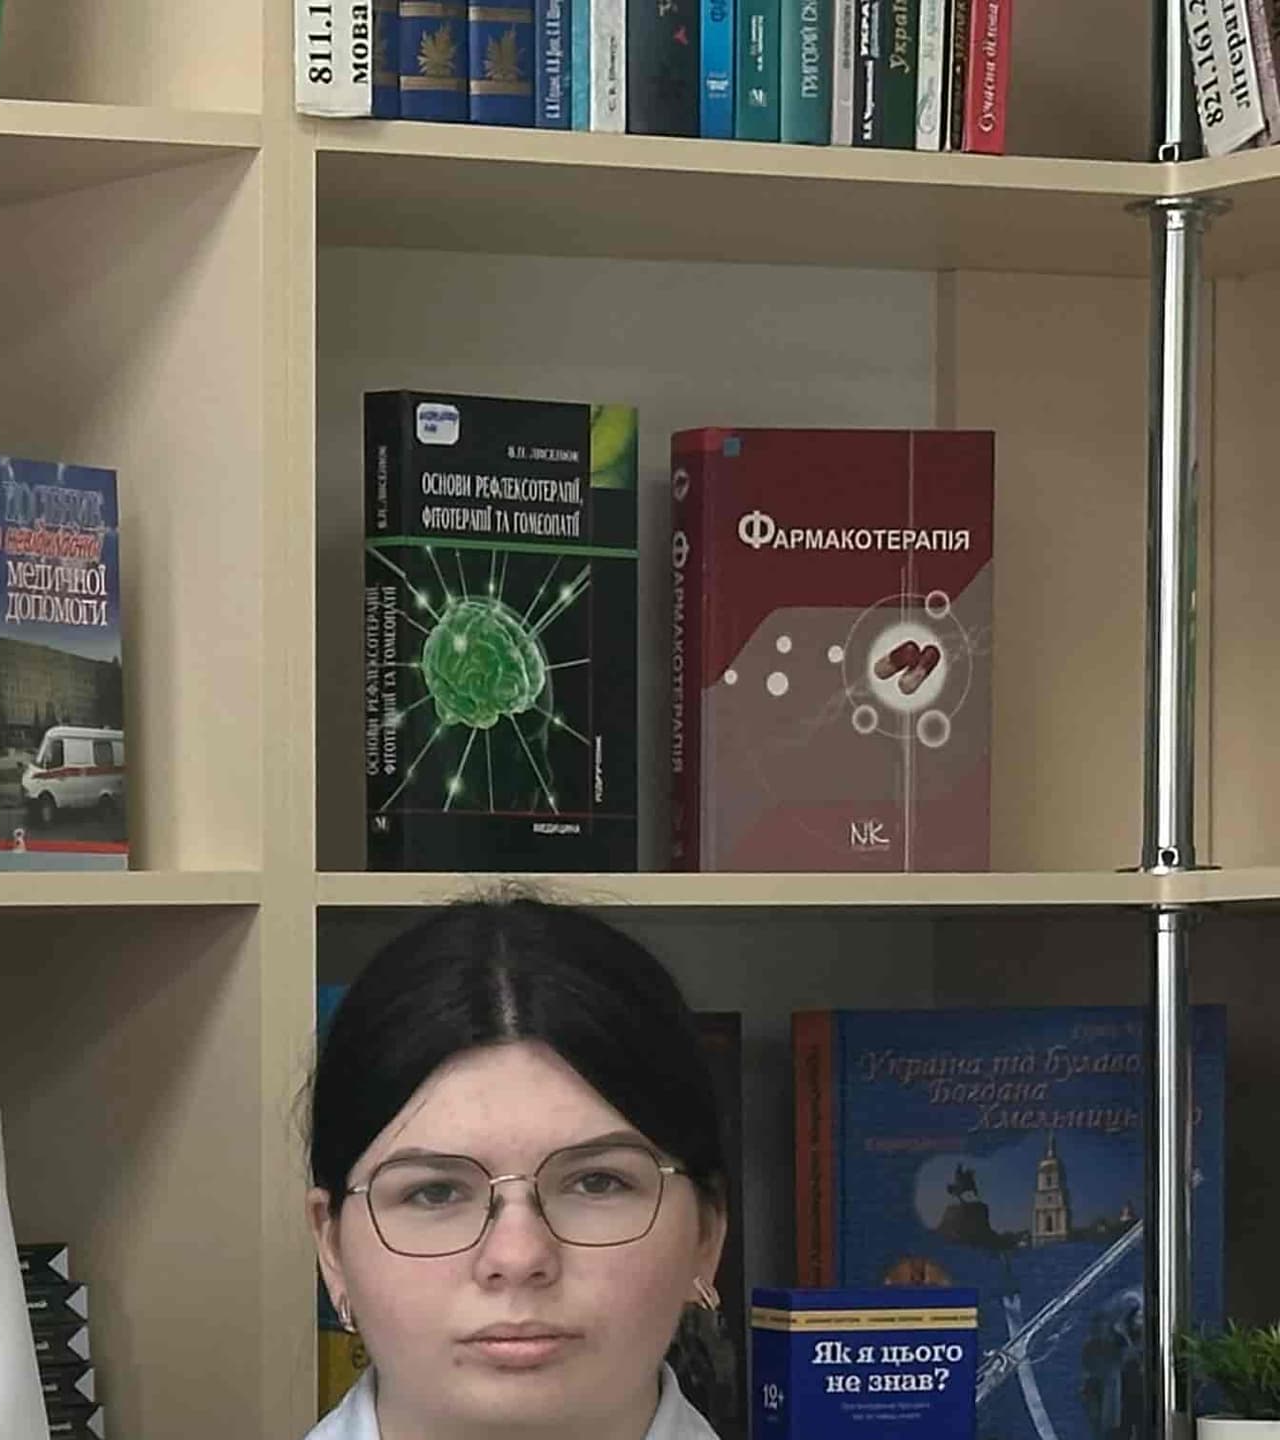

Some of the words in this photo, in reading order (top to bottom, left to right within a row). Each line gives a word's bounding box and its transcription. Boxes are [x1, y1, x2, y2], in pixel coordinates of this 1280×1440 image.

[422, 472, 471, 495] ОСНОВИ
[496, 510, 511, 533] ТА
[513, 511, 580, 538] ГОМЕОПАТІЇ
[738, 510, 970, 550] ФАРМАКОТЕРАПІЯ
[815, 1342, 853, 1364] Як
[859, 1346, 875, 1364] я
[881, 1344, 963, 1367] цього
[826, 1375, 861, 1393] не
[869, 1367, 951, 1392] знав?
